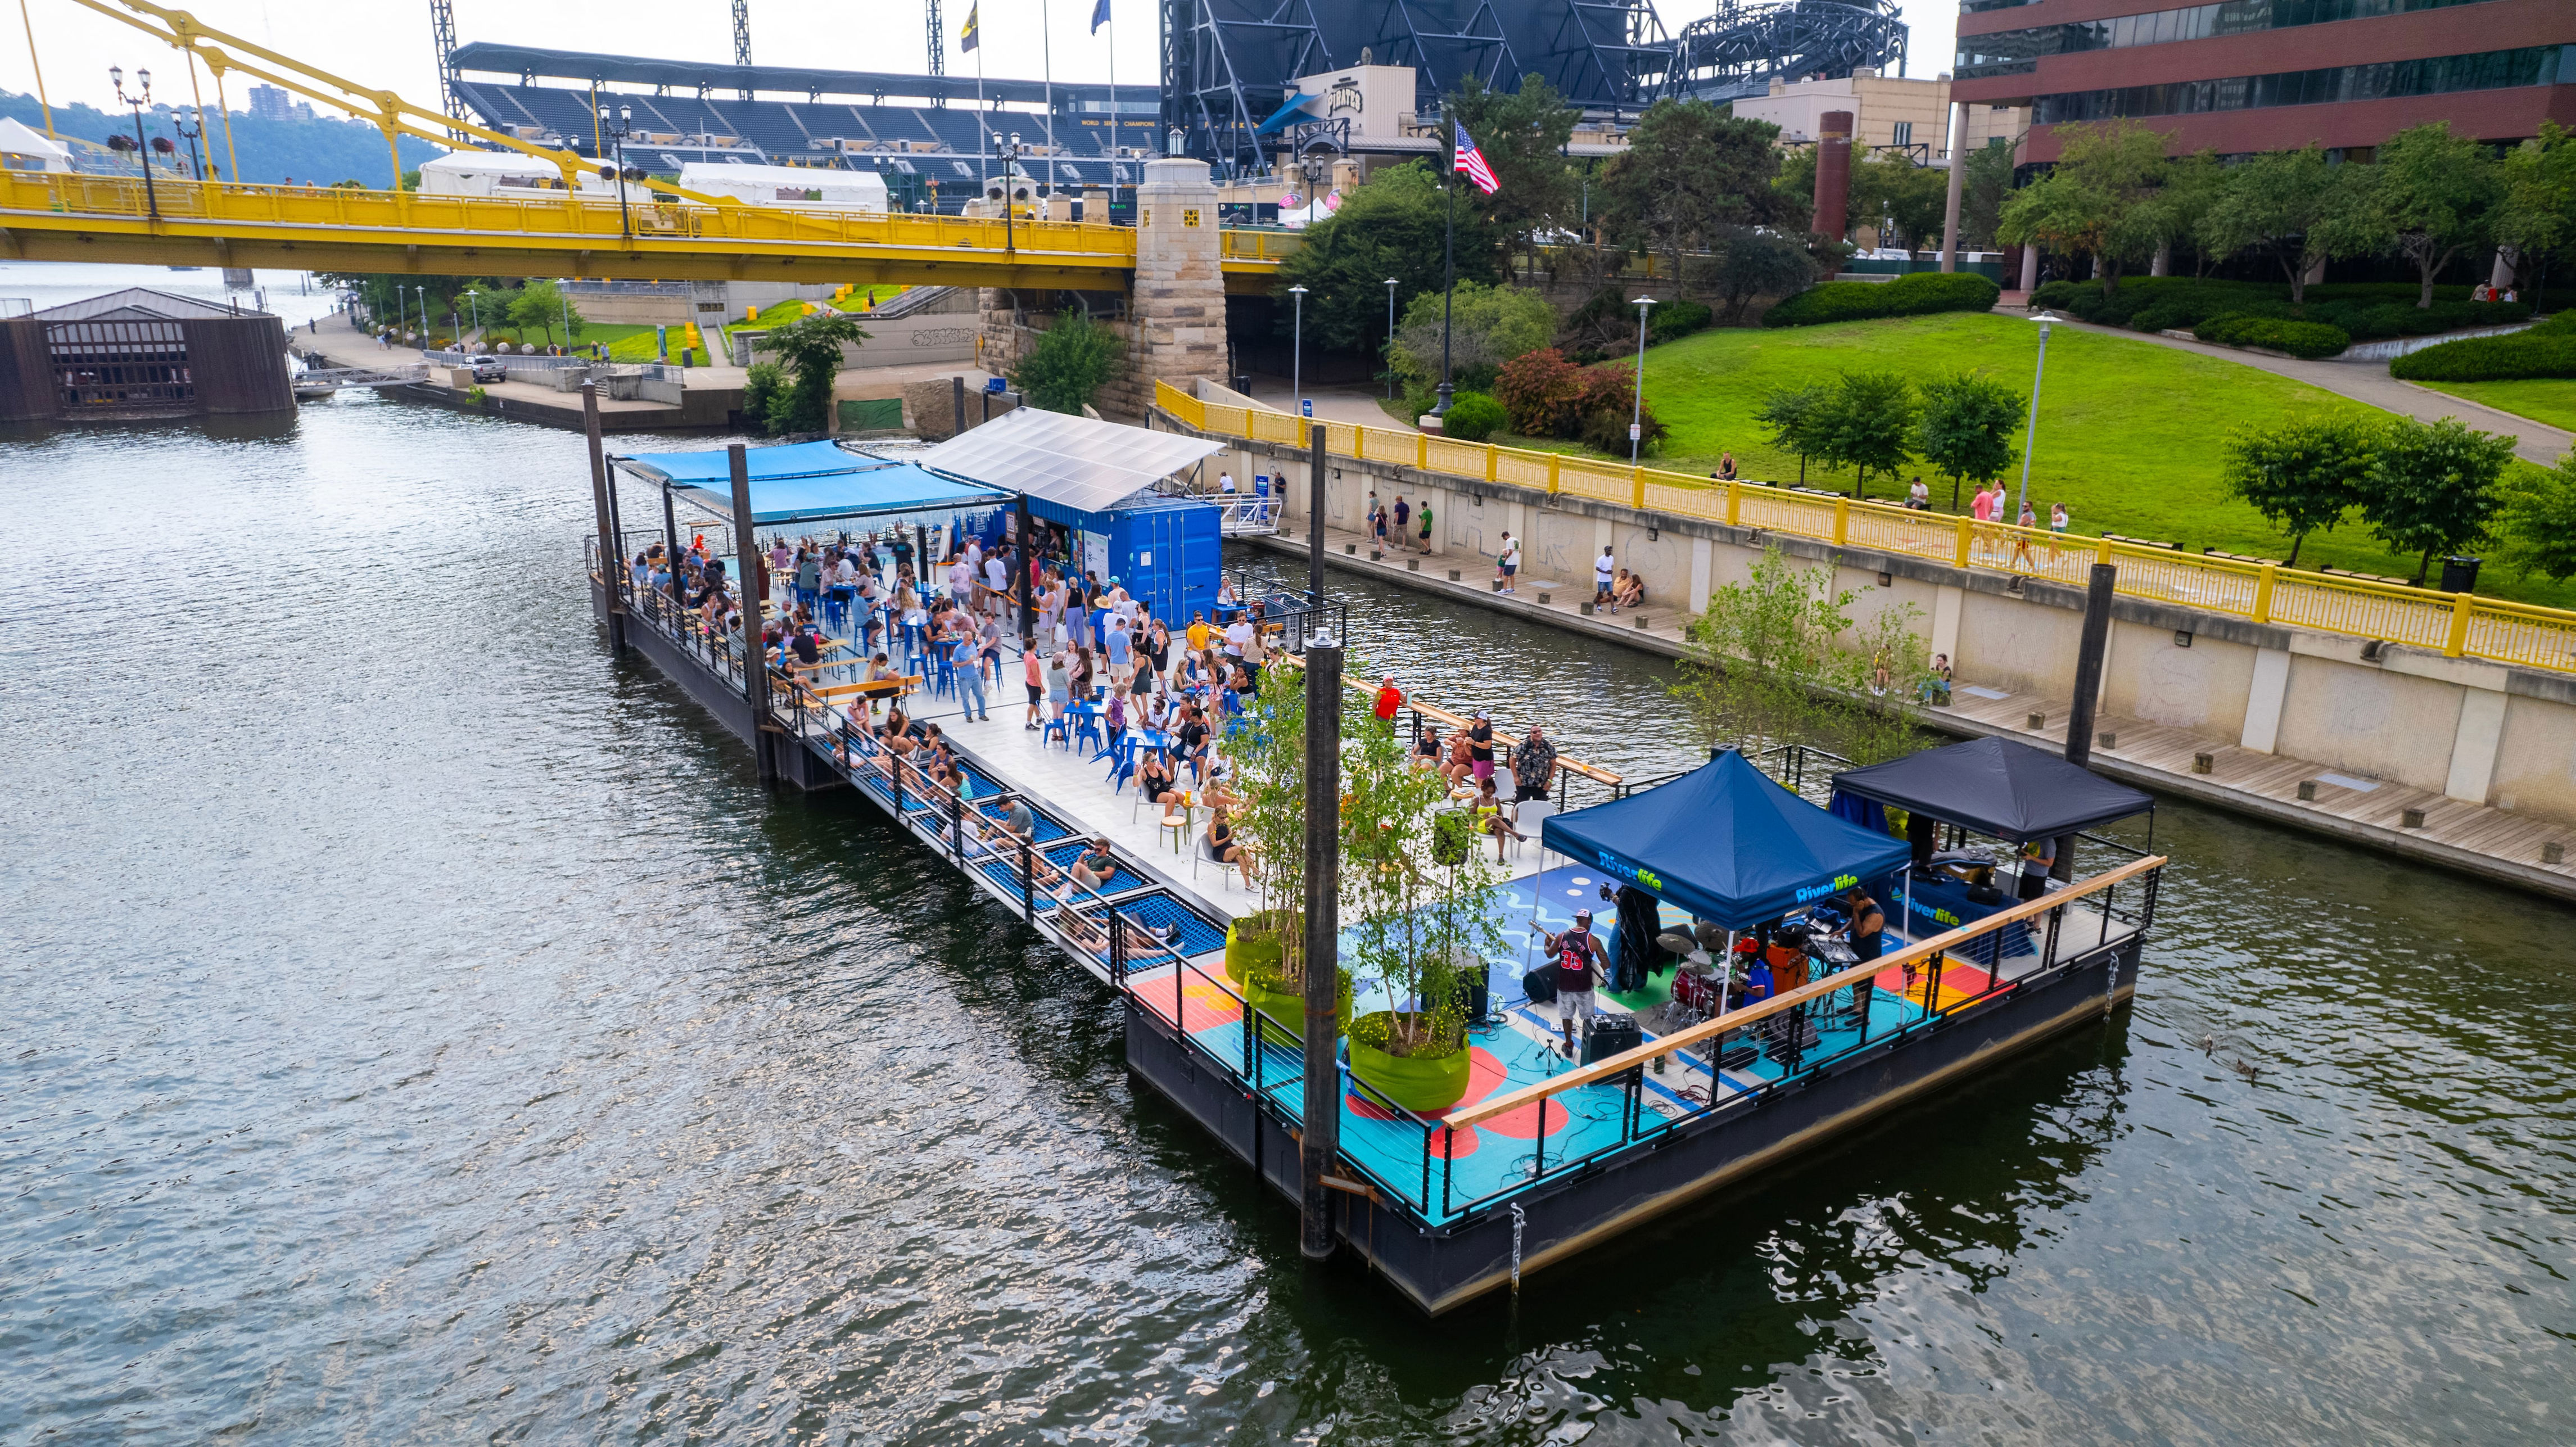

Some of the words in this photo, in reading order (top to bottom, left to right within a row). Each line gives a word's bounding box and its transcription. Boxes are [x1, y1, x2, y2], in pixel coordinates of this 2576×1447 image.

[1328, 88, 1362, 117] PIRATES
[1599, 851, 1662, 892] Riverlife
[1796, 874, 1858, 904] Riverlife
[1561, 949, 1583, 971] 33
